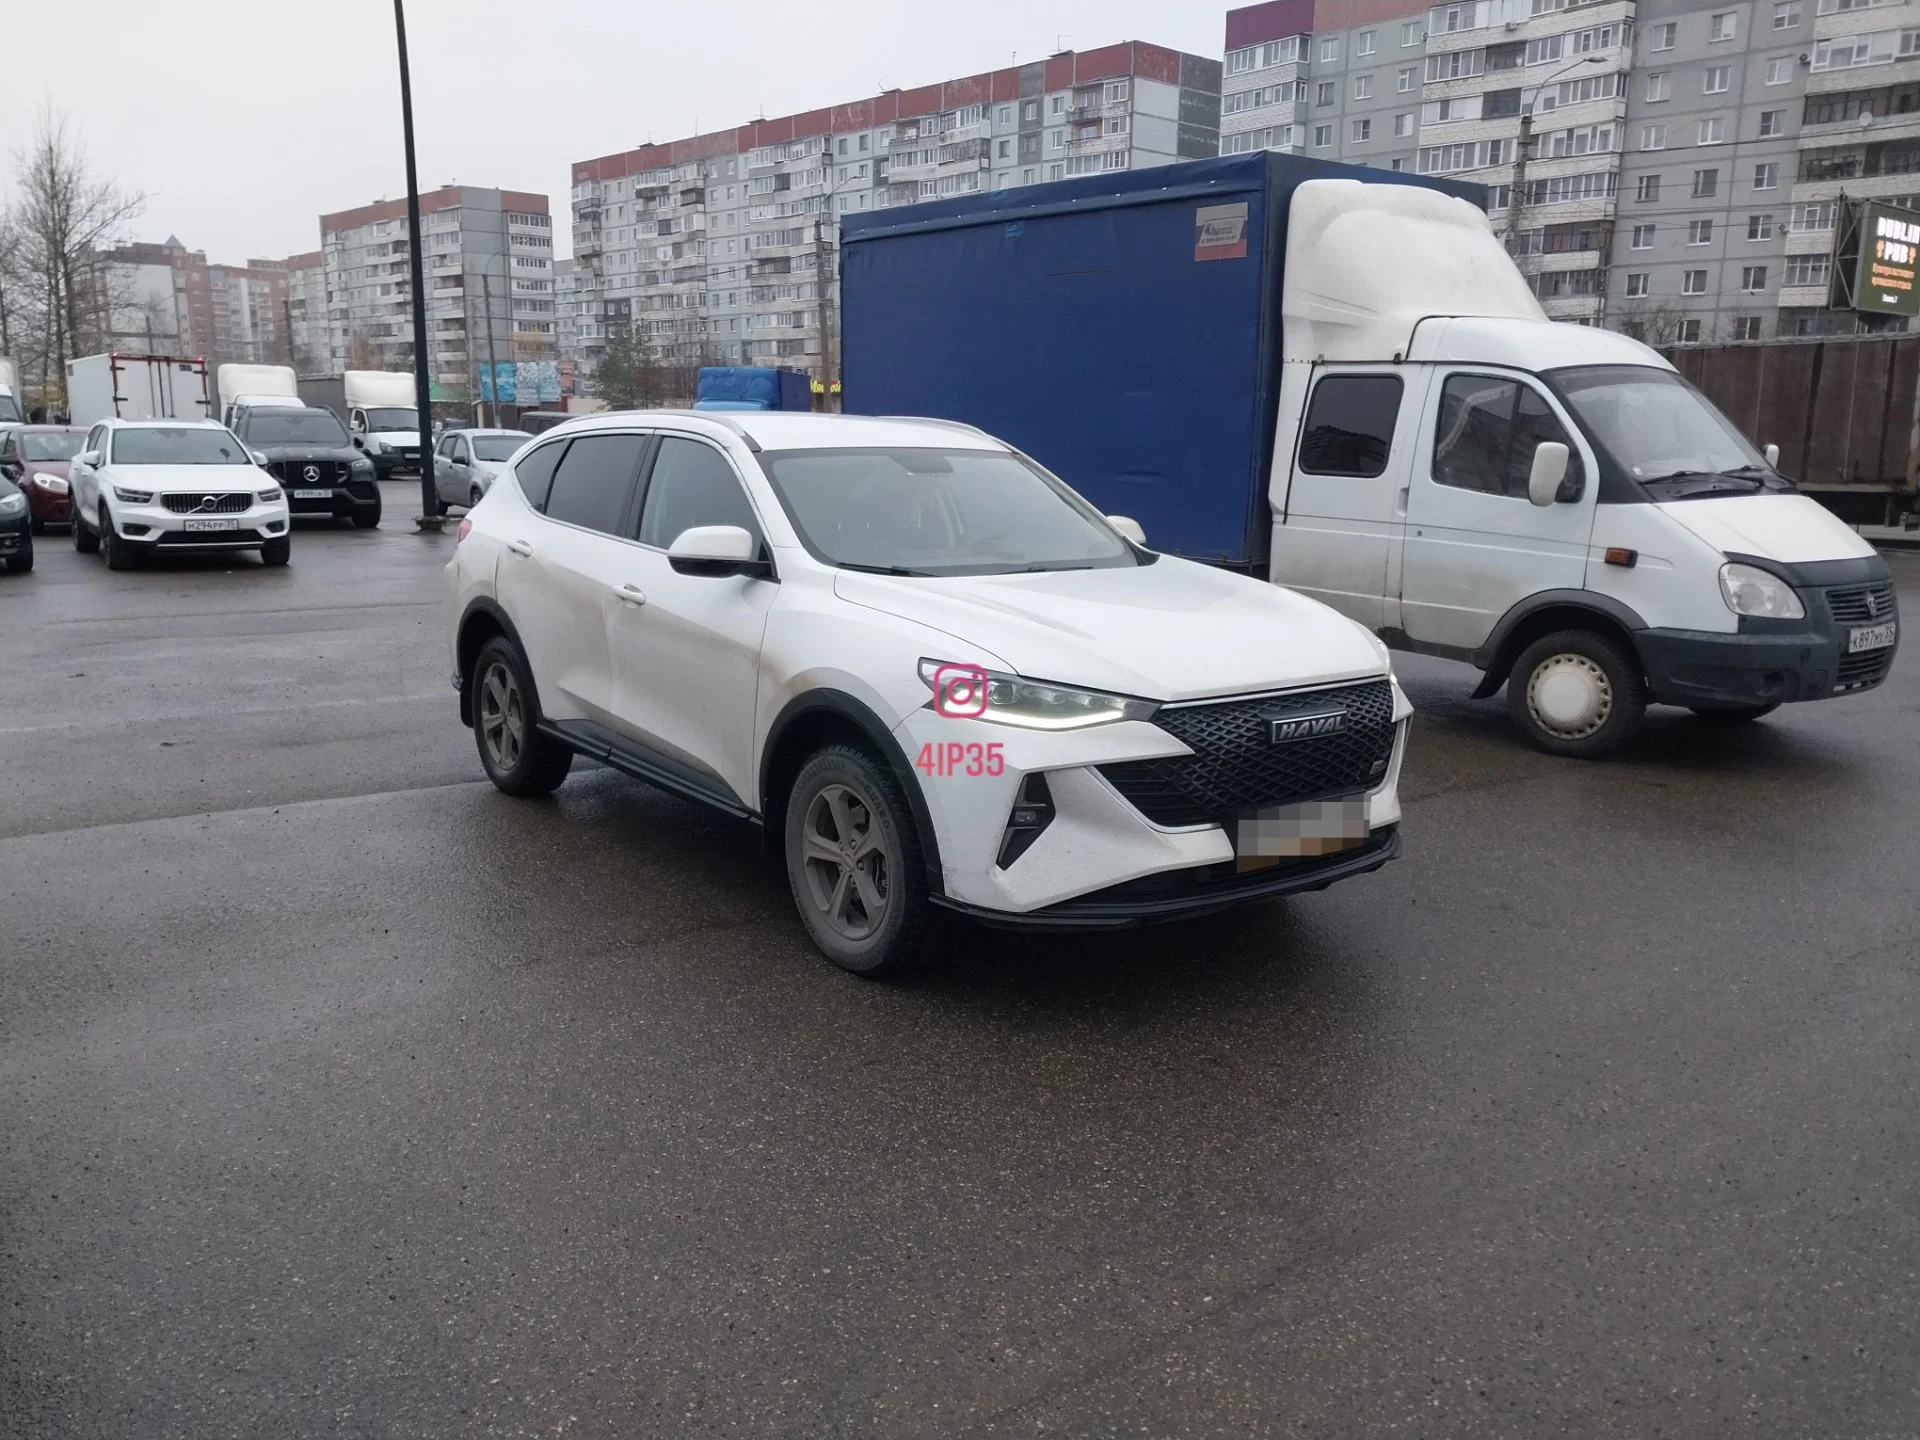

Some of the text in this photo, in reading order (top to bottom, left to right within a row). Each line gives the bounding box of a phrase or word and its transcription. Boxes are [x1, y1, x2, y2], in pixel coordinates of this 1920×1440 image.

[1876, 216, 1920, 245] DUBLIN
[1884, 241, 1909, 264] PUB
[1278, 716, 1346, 740] HAVAL
